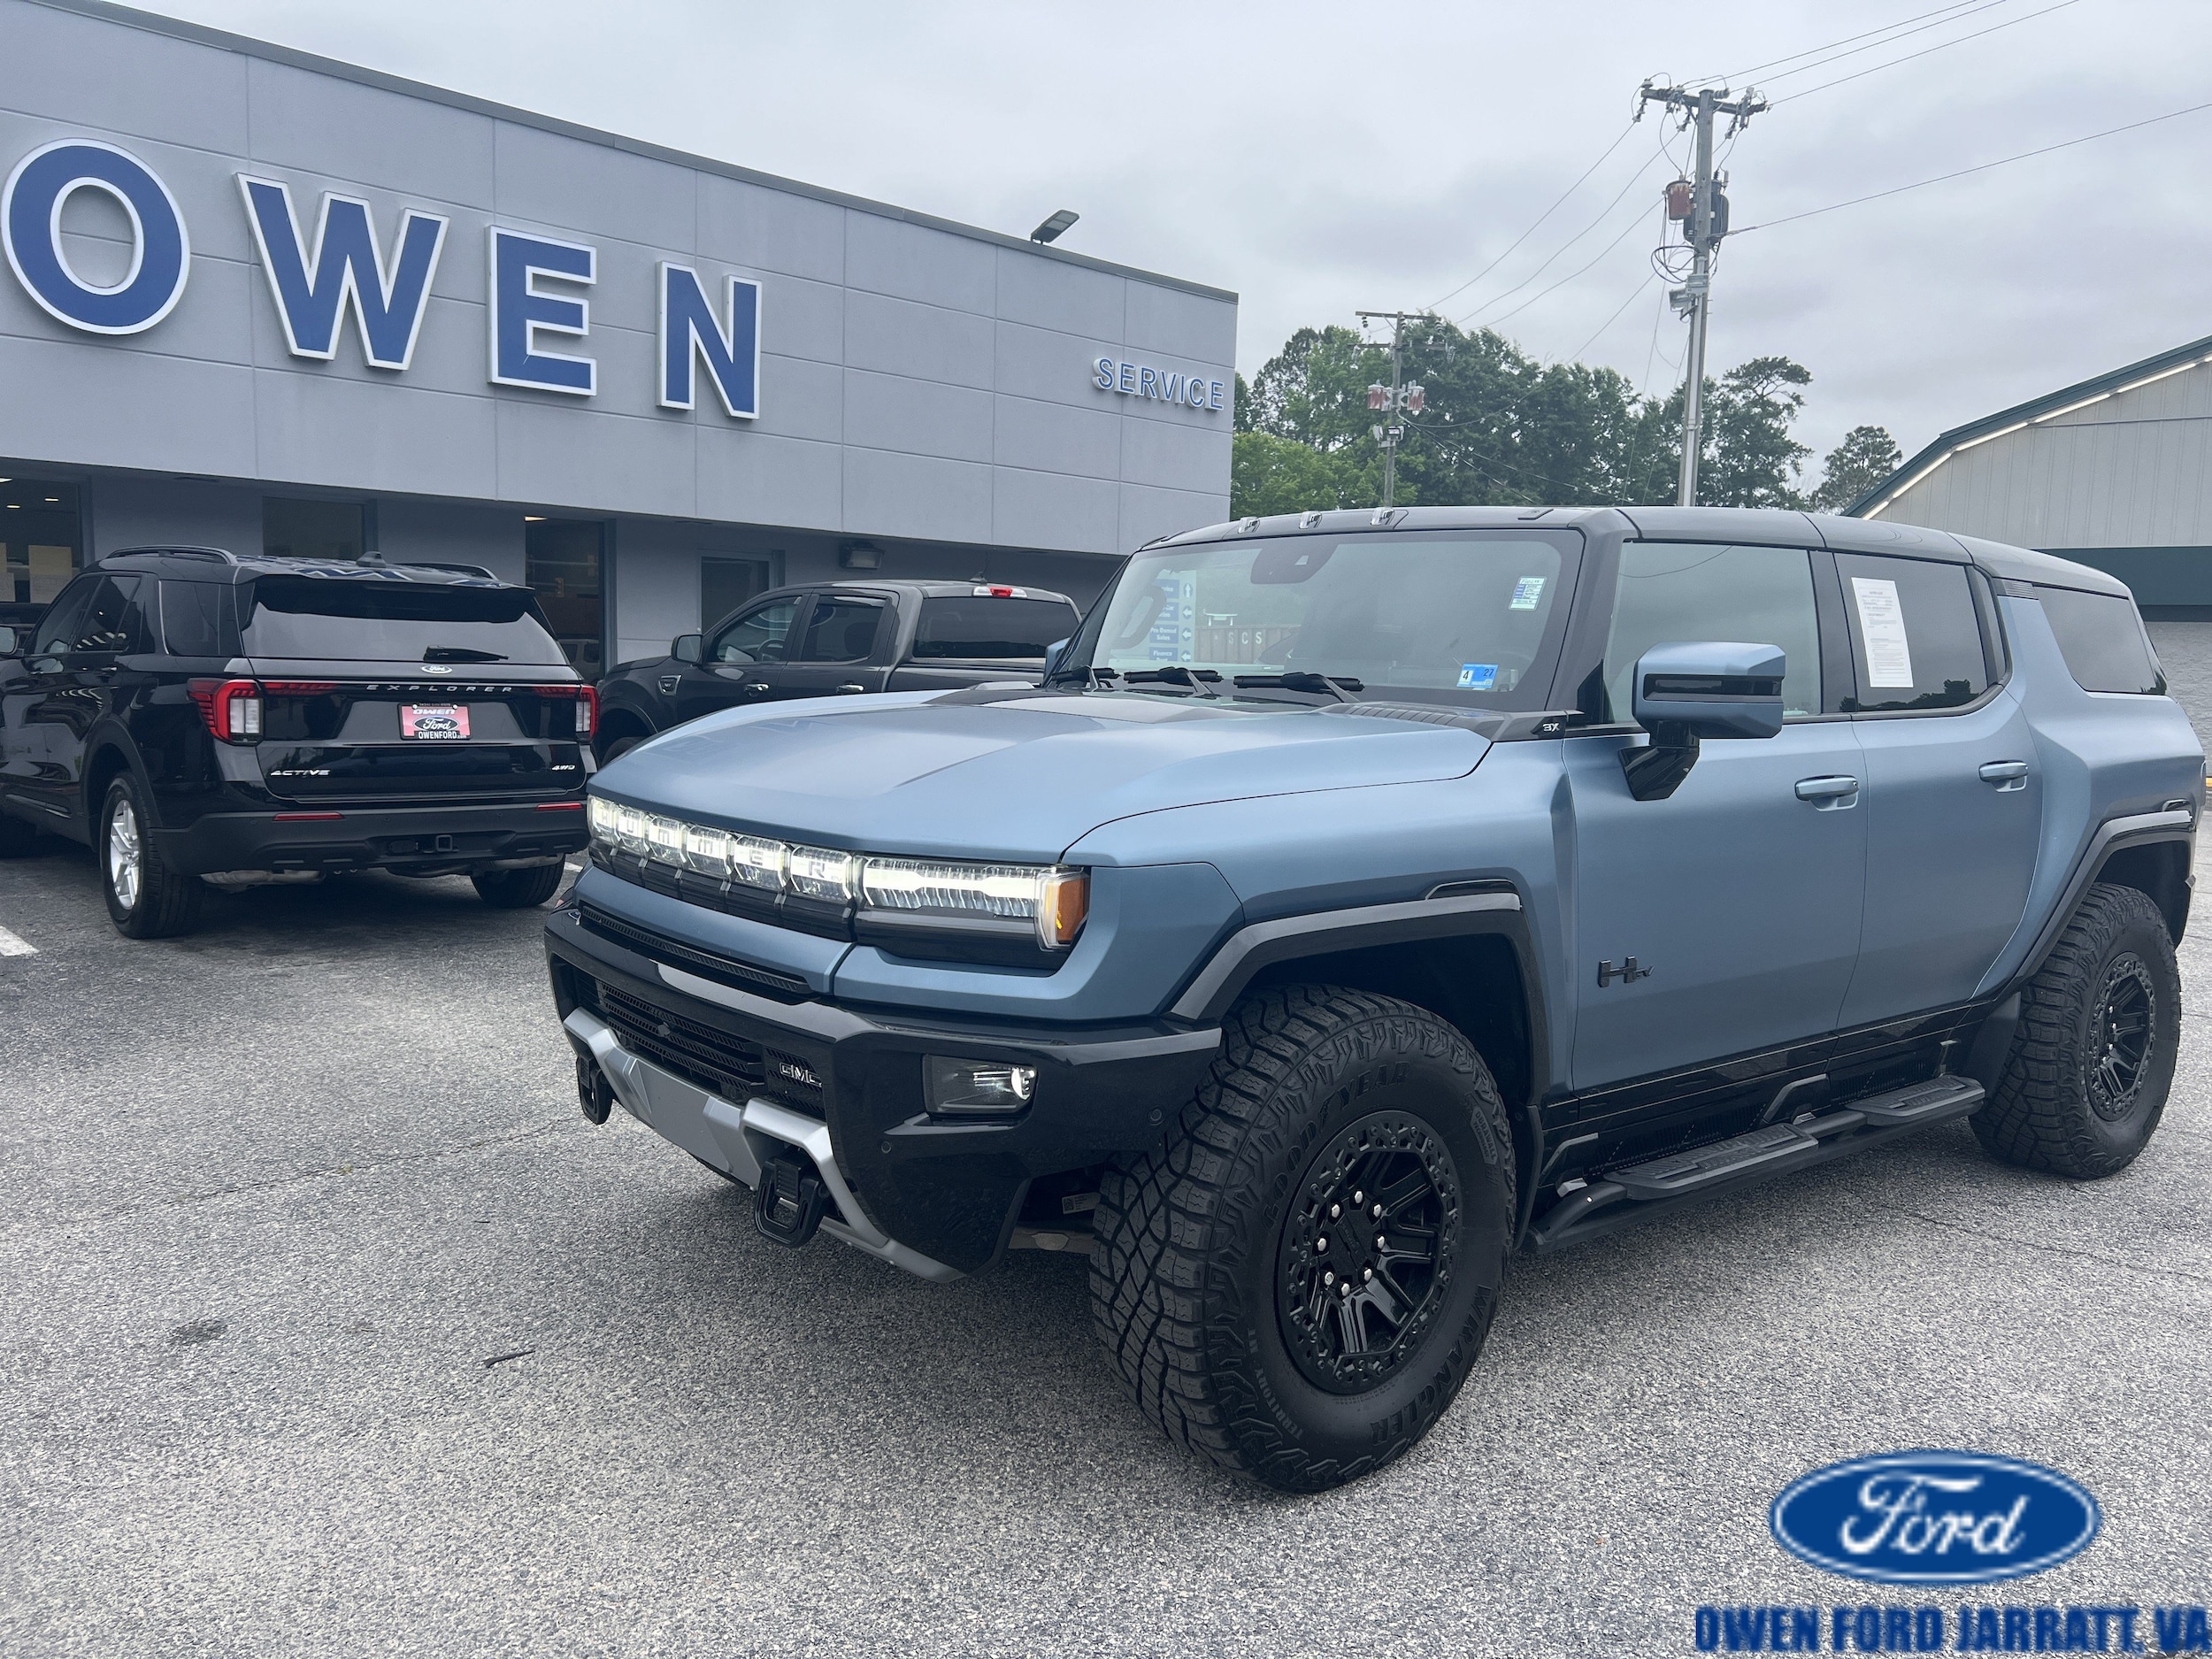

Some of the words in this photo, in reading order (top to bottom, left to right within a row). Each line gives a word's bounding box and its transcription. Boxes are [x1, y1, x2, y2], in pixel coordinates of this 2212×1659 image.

[1, 138, 762, 419] OWEN
[1093, 357, 1225, 411] SERVICE
[1463, 671, 1470, 680] 4
[365, 684, 512, 693] EXPLORER
[423, 718, 451, 729] Ford
[1542, 723, 1560, 732] 3X
[596, 808, 826, 879] HUMMER
[780, 1062, 822, 1087] GMC
[1371, 1284, 1494, 1447] WRANGLER
